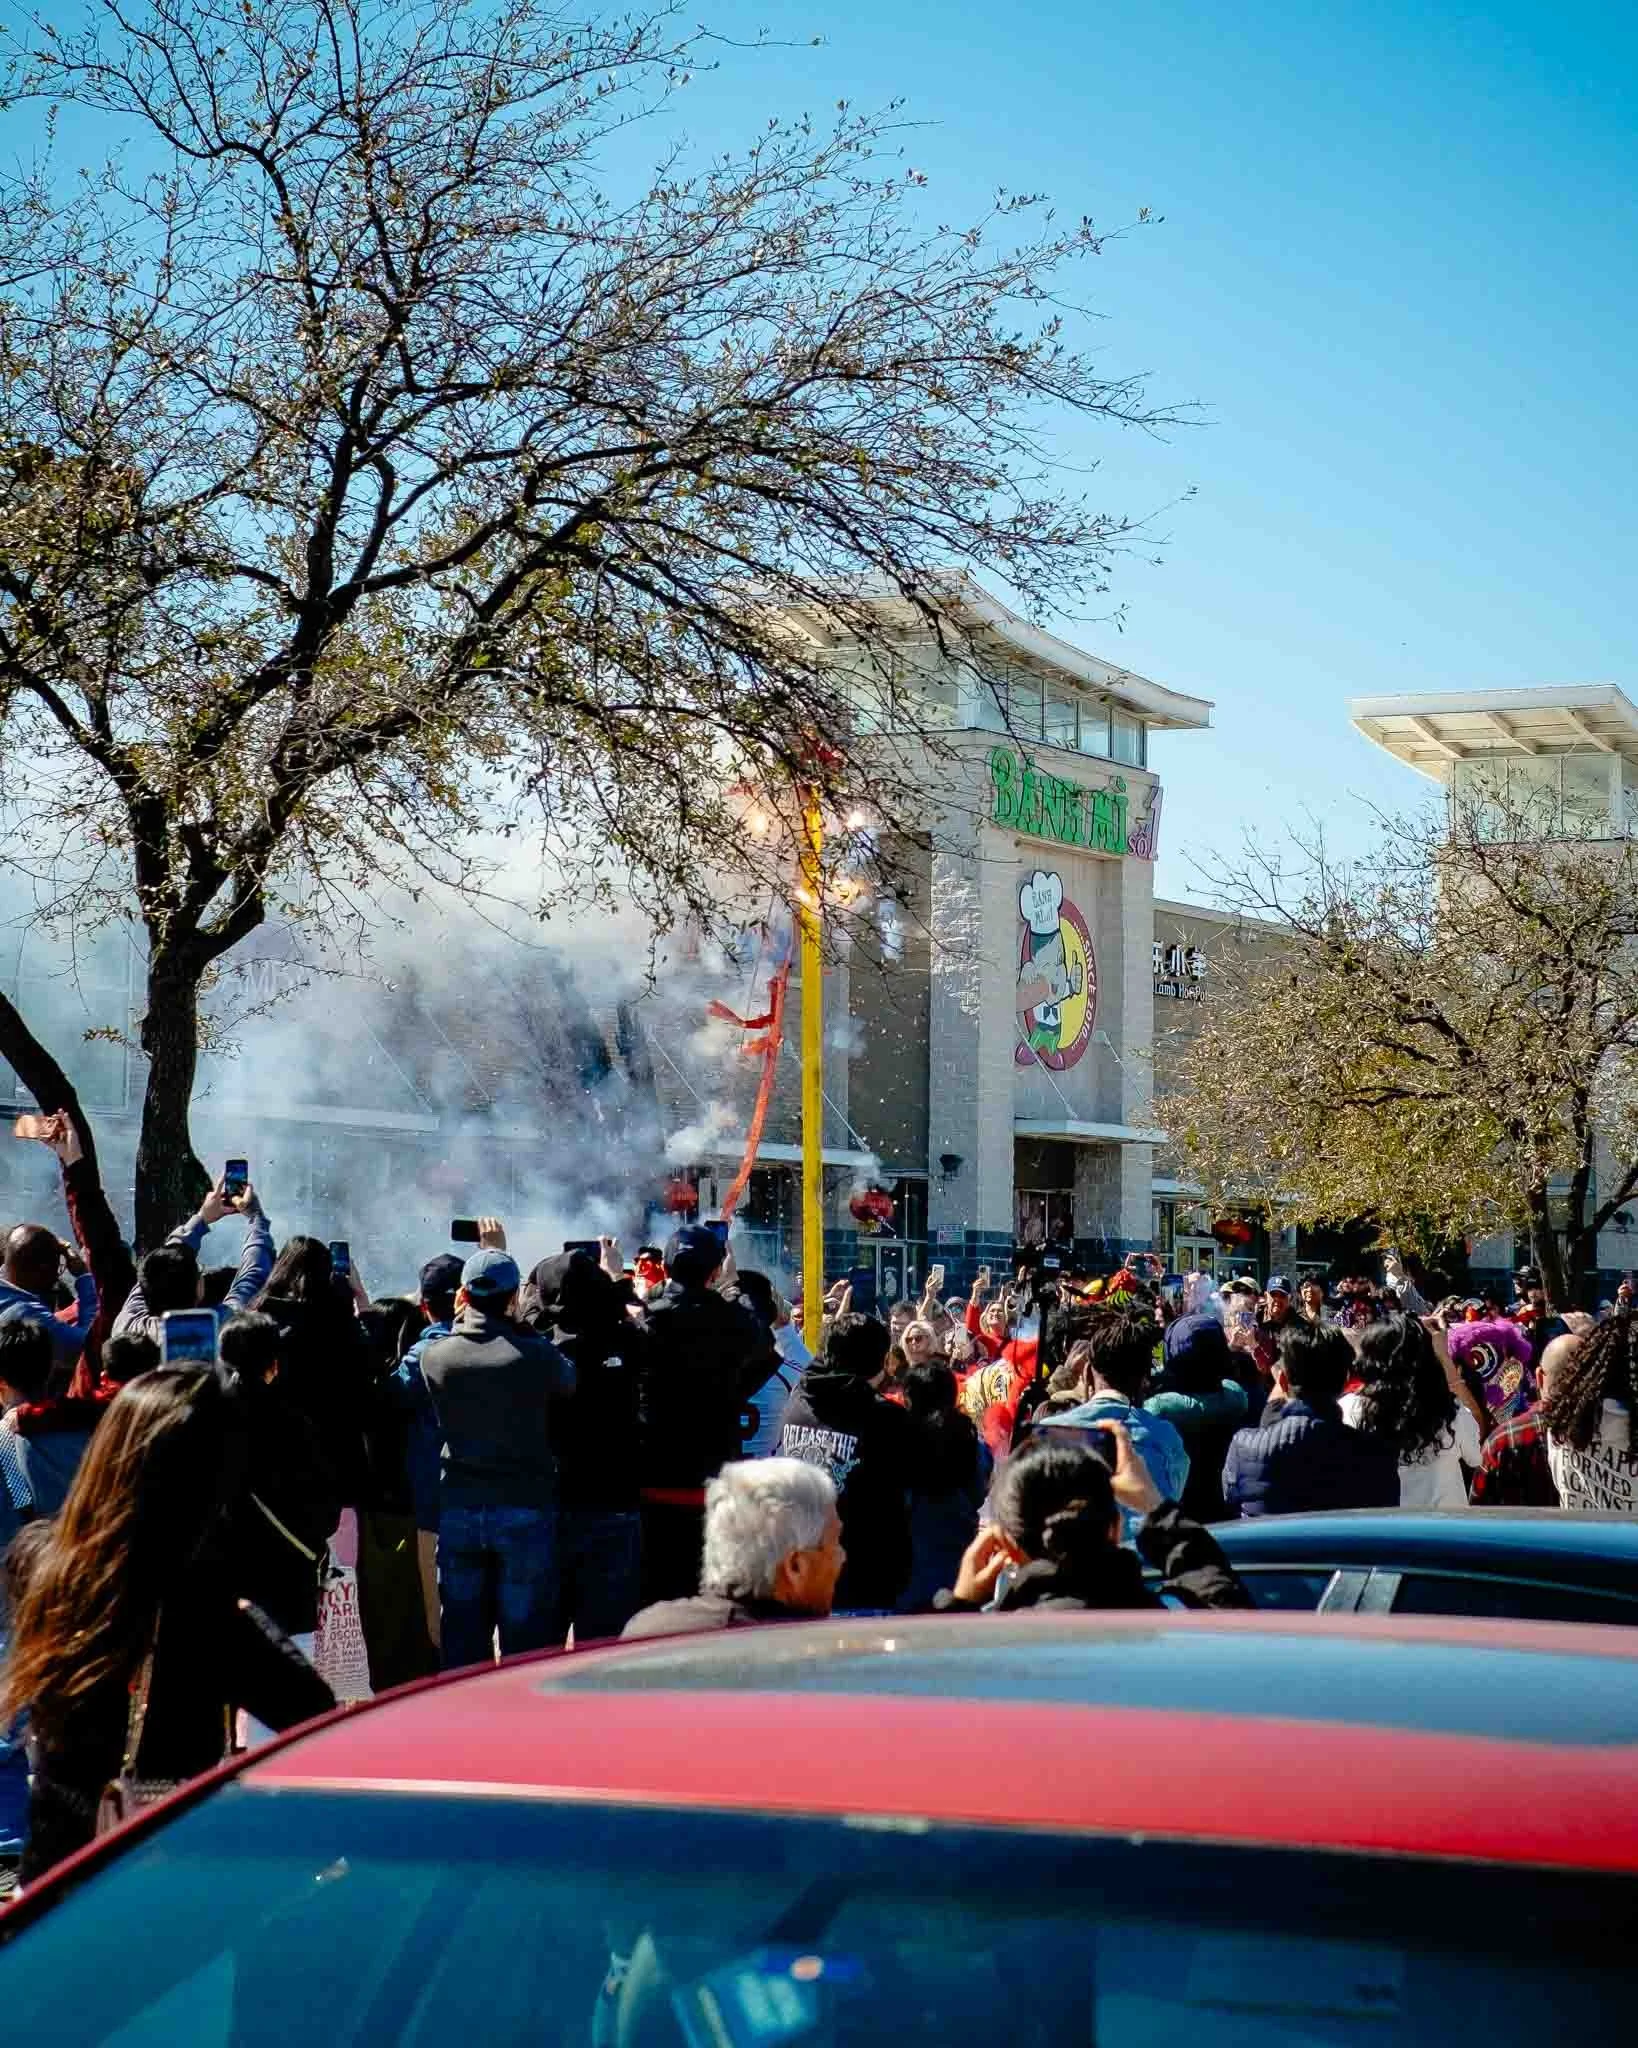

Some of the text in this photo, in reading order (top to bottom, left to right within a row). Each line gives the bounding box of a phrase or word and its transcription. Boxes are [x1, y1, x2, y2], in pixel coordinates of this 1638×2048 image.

[1080, 940, 1096, 1039] SINCE 2010
[1154, 978, 1177, 997] Lamb
[783, 1424, 829, 1457] RELEASE
[832, 1431, 858, 1461] THE
[1562, 1448, 1632, 1497] FORMED
